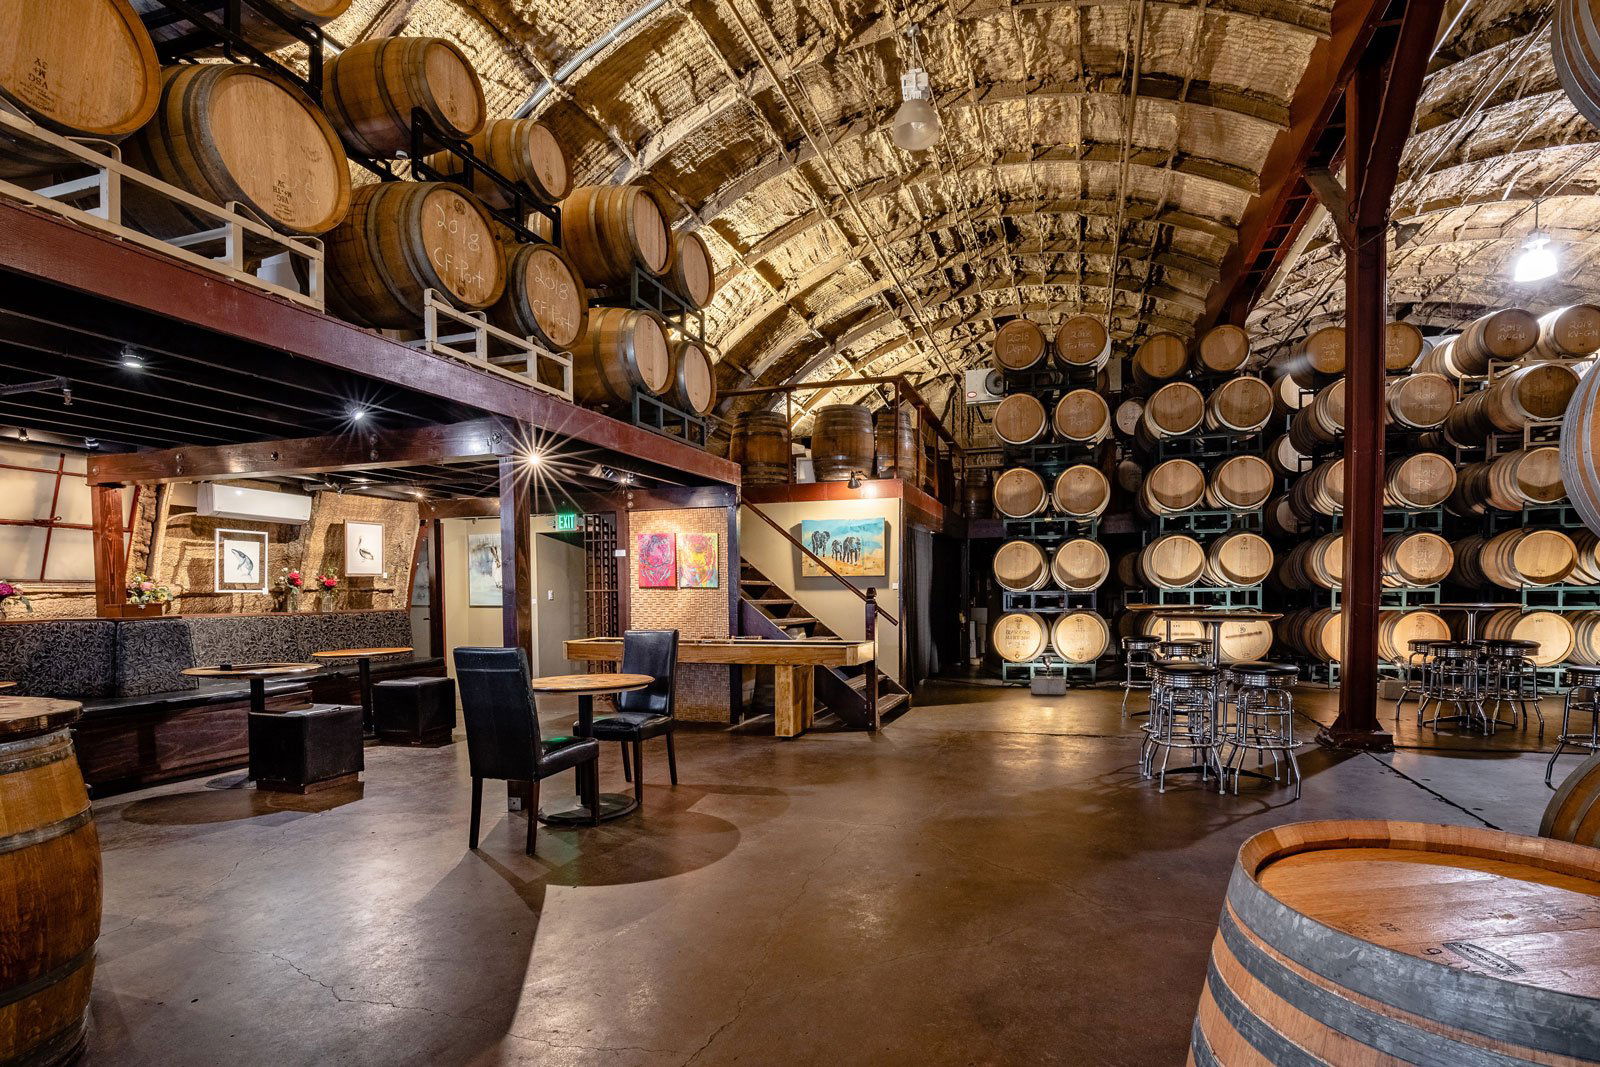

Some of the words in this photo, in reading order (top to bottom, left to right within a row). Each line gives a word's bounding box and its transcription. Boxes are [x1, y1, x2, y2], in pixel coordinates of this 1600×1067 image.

[436, 203, 481, 252] 2018
[433, 247, 454, 272] CF
[456, 259, 485, 289] Port
[534, 265, 569, 300] 2018
[532, 299, 548, 317] CF
[548, 305, 575, 331] Port
[559, 515, 575, 529] EXIT
